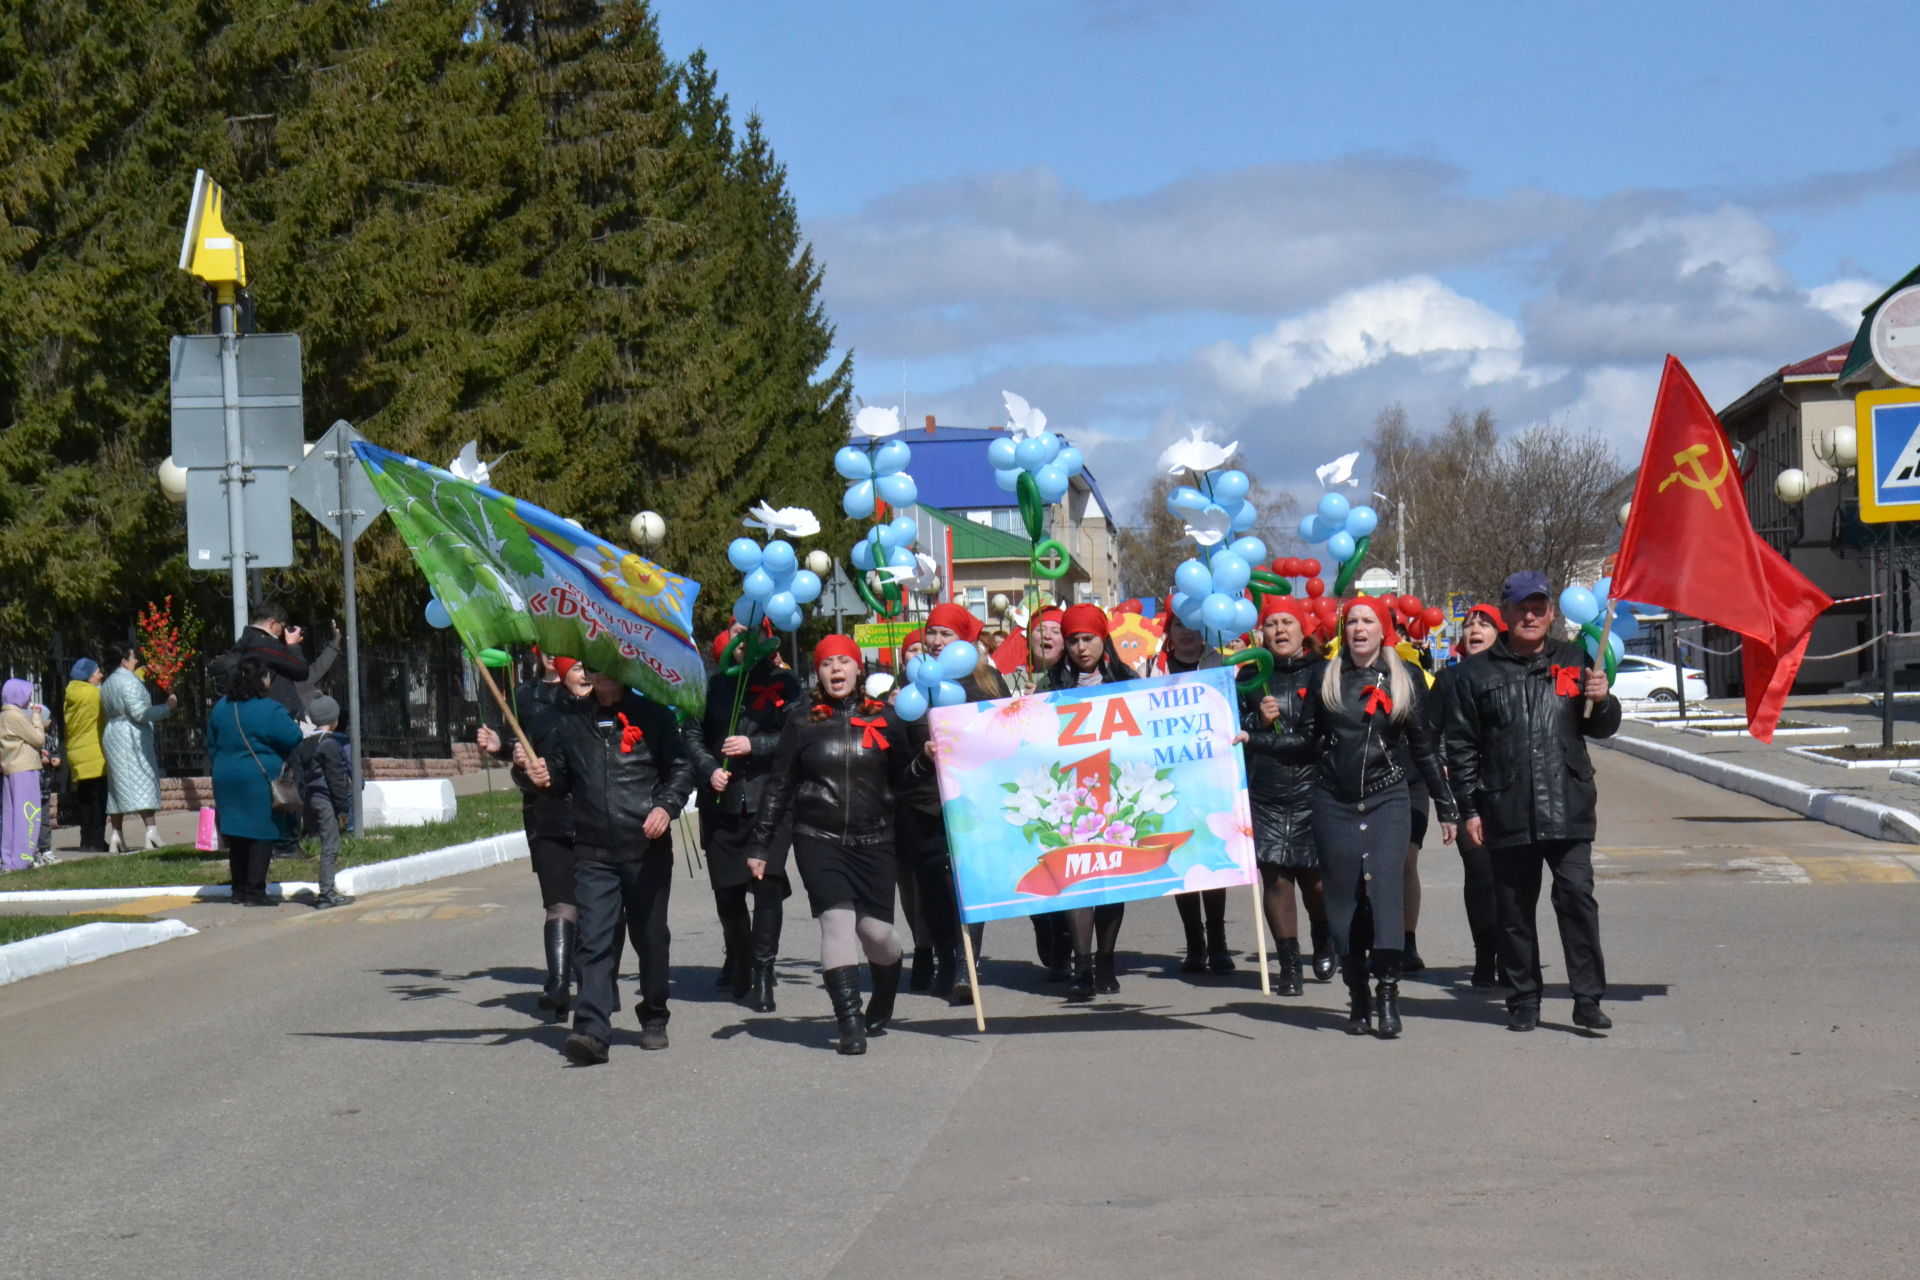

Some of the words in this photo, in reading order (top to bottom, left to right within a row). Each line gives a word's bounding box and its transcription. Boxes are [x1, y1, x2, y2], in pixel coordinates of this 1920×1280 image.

[1148, 685, 1205, 710] МИР
[1148, 712, 1214, 738] ТРУД
[1153, 734, 1214, 766] МАЙ
[1059, 748, 1111, 833] 1
[1065, 851, 1123, 878] МАЯ
